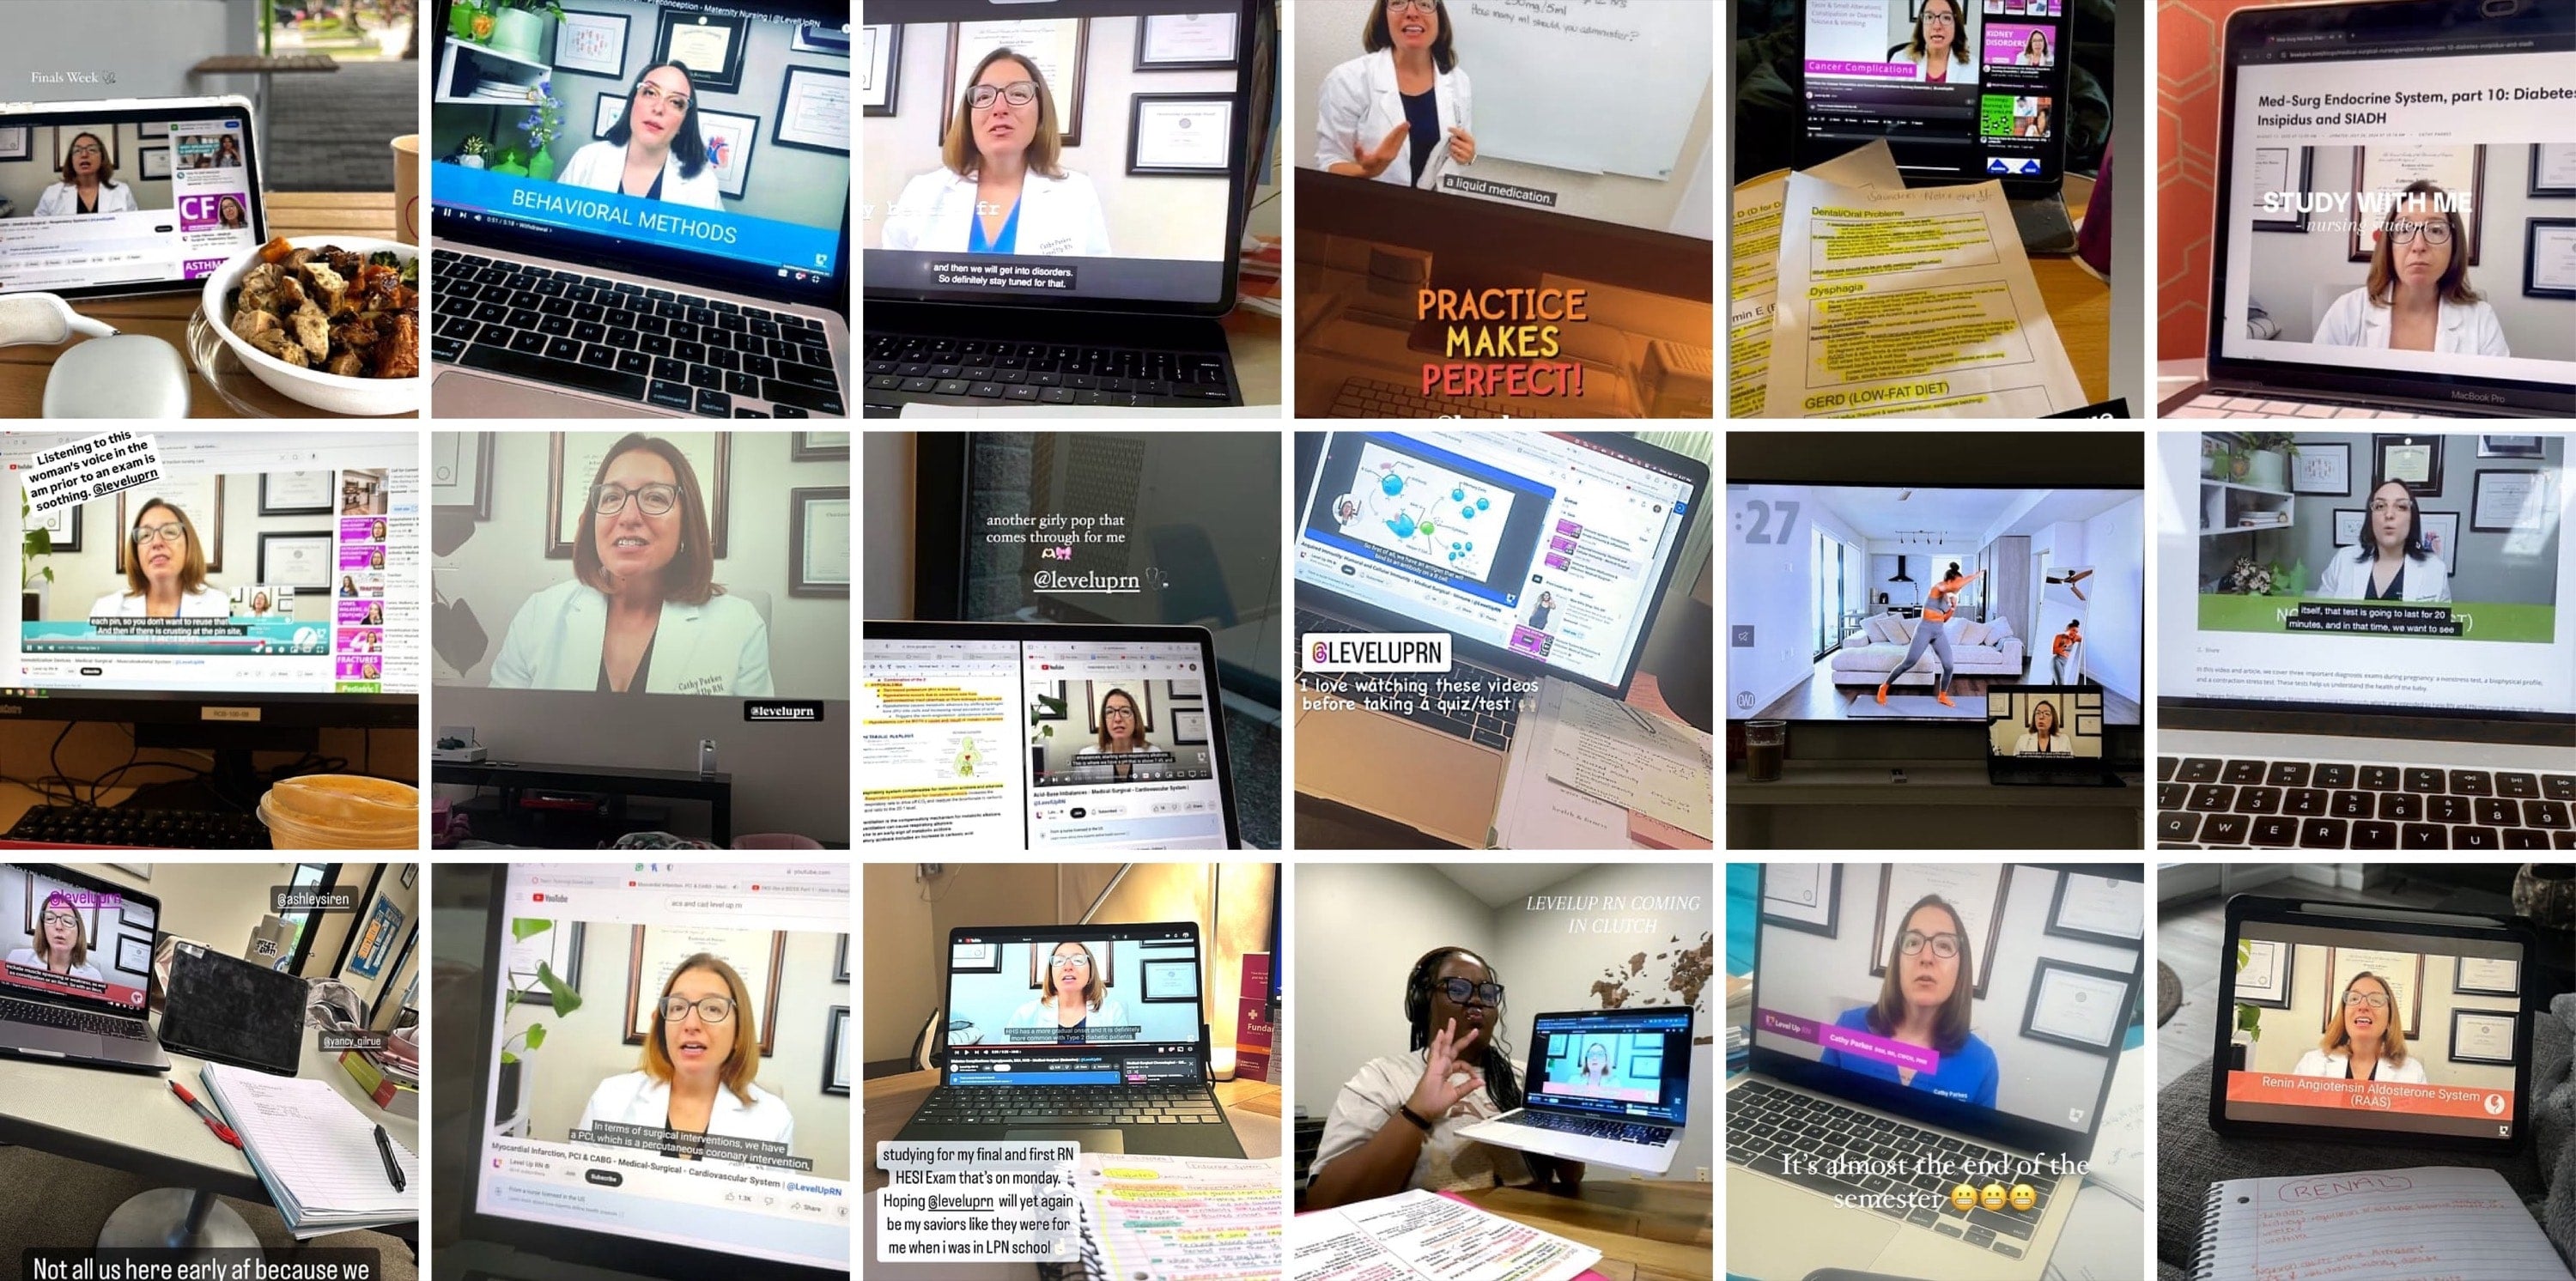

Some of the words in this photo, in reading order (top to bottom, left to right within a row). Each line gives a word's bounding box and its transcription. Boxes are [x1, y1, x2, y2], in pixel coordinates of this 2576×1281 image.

[704, 5, 738, 18] Maternity
[739, 10, 768, 21] Nursing
[773, 13, 821, 28] @LevelUpRN
[1472, 3, 1489, 16] How
[1492, 11, 1514, 23] many
[1518, 13, 1529, 23] ml
[1533, 19, 1560, 31] should
[1564, 24, 1577, 33] you
[1986, 30, 2014, 39] KIDNEY
[1808, 61, 1842, 71] Cancer
[1845, 63, 1913, 75] Complications
[2258, 94, 2321, 109] Med-Surg
[2324, 92, 2391, 106] Endocrine
[2394, 91, 2448, 107] System,
[2451, 89, 2482, 106] part
[2488, 88, 2510, 102] 10:
[2257, 113, 2312, 129] Insipidus
[2316, 113, 2342, 125] and
[2345, 112, 2386, 125] SIADH
[1446, 177, 1454, 186] a
[1456, 177, 1486, 191] liquid
[1488, 185, 1552, 204] medication.
[180, 197, 215, 220] CF
[512, 189, 632, 226] BEHAVIORAL
[637, 211, 738, 244] METHODS
[1811, 206, 1863, 217] Dental/Oral
[1864, 209, 1905, 217] Problems
[933, 263, 949, 272] and
[951, 263, 969, 273] then
[985, 264, 998, 274] will
[999, 265, 1013, 276] get
[1014, 265, 1030, 276] into
[1031, 266, 1073, 276] disorders.
[1809, 283, 1863, 296] Dysphagia
[1805, 393, 1845, 410] GERD
[1848, 386, 1911, 406] (LOW-FAT
[1915, 381, 1950, 396] DIET)
[2451, 391, 2489, 402] MacBook
[2491, 394, 2505, 403] Pro
[2300, 605, 2323, 616] itself,
[2324, 607, 2341, 616] that
[2342, 608, 2359, 616] test
[2360, 608, 2367, 616] is
[2368, 609, 2392, 620] going
[2404, 610, 2420, 618] last
[2421, 610, 2433, 618] for
[2434, 610, 2445, 619] 20
[678, 680, 698, 691] Cathy
[699, 675, 723, 686] Parkes
[544, 894, 568, 903] YouTube
[1248, 1023, 1274, 1033] Funda
[1775, 1019, 1791, 1030] Level
[1791, 1023, 1801, 1034] Up
[1830, 1034, 1850, 1047] Cathy
[1850, 1038, 1873, 1052] Parkes
[1933, 1089, 1948, 1097] Cathy
[1948, 1090, 1968, 1099] Parkes
[2262, 1076, 2294, 1089] Renin
[2298, 1078, 2364, 1094] Angiotensin
[2367, 1084, 2435, 1099] Aldosterone
[2438, 1089, 2481, 1102] System
[2350, 1094, 2391, 1109] (RAAS)
[594, 1122, 603, 1131] In
[604, 1124, 629, 1134] terms
[631, 1126, 641, 1135] of
[643, 1128, 678, 1140] surgical
[681, 1132, 743, 1149] interventions,
[762, 1143, 786, 1154] have
[492, 1142, 530, 1155] Myocardial
[532, 1146, 567, 1159] Infarction,
[568, 1152, 581, 1161] PCI
[590, 1155, 611, 1164] CABG
[618, 1159, 682, 1175] Medical-Surgical
[689, 1168, 747, 1183] Cardiovascular
[749, 1176, 781, 1188] System
[787, 1182, 842, 1198] @LevelUpRN
[2294, 1178, 2401, 1198] RENAL
[804, 1204, 822, 1212] Share
